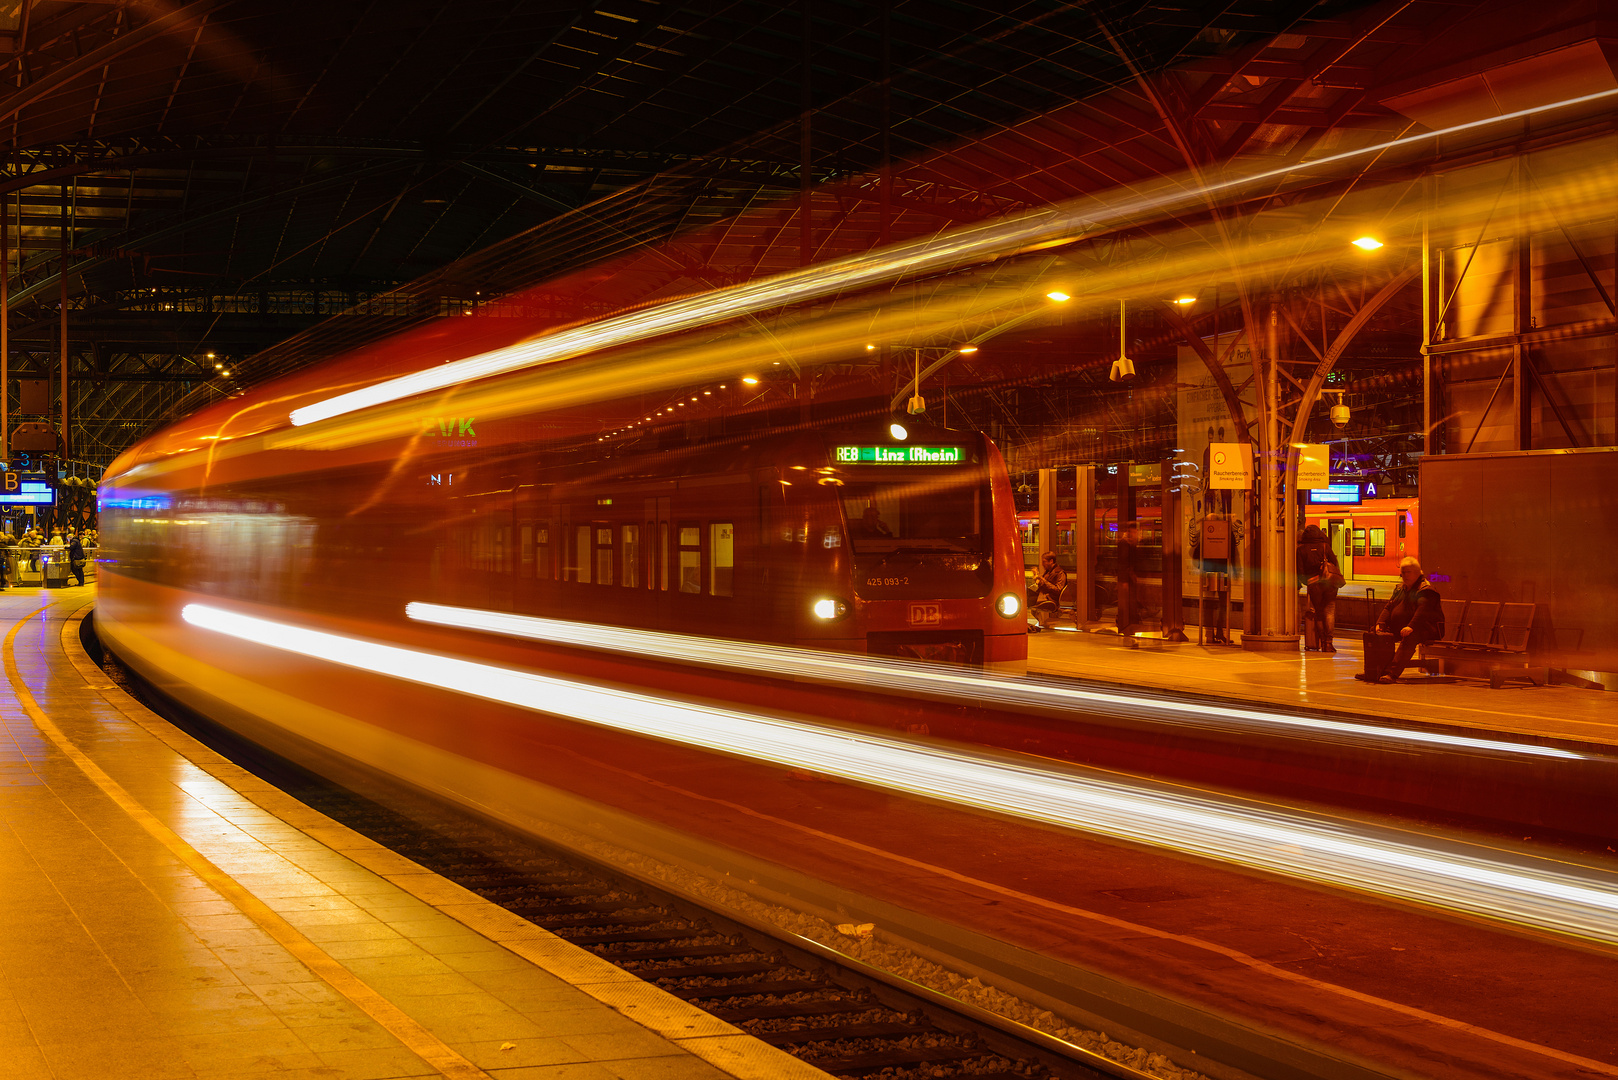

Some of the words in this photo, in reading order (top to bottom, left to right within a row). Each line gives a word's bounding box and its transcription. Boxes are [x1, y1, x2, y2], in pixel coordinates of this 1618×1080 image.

[836, 446, 859, 462] RE8
[875, 446, 905, 462] Linz
[909, 446, 959, 462] (Rhein)
[5, 472, 19, 490] B
[1366, 482, 1376, 495] A
[866, 577, 883, 586] 425
[884, 576, 910, 586] 093-2
[911, 604, 940, 625] DB
